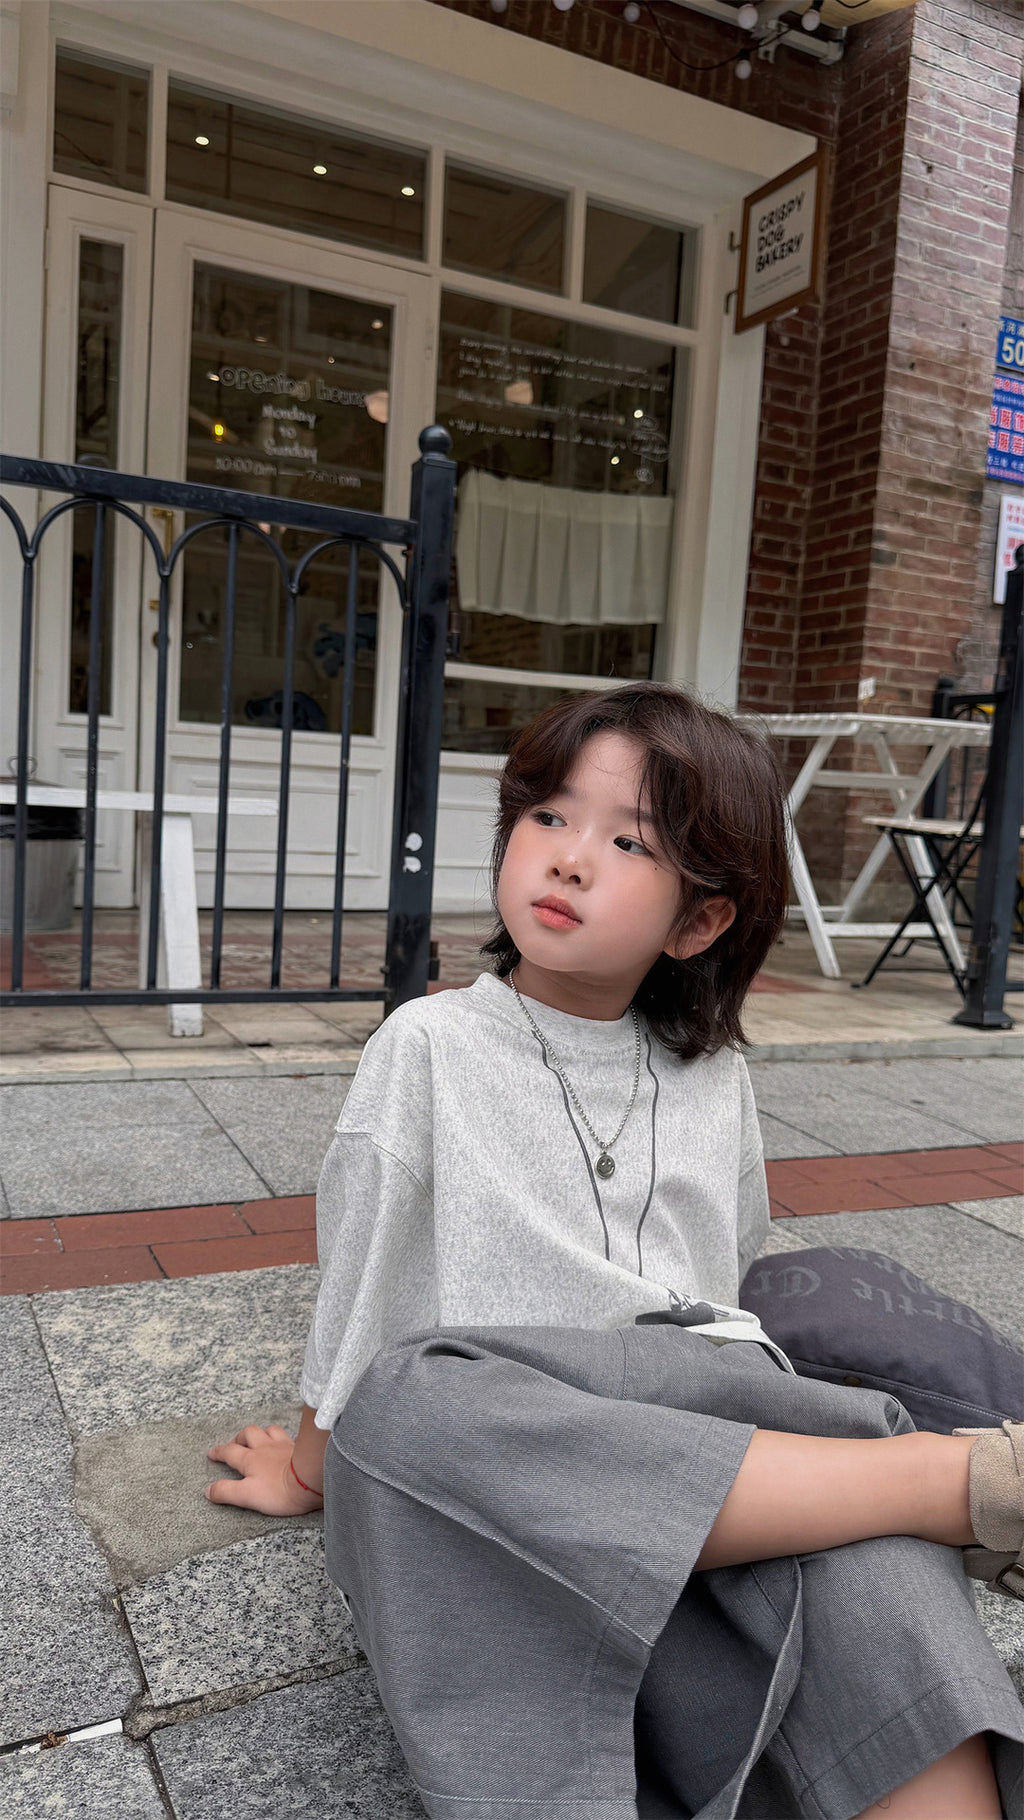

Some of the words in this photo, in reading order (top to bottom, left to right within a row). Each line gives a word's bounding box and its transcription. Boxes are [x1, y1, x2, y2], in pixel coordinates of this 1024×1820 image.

[758, 191, 805, 233] CRISPY
[757, 224, 785, 252] DOG
[755, 232, 804, 273] BAKERY
[262, 403, 317, 430] Monday
[264, 440, 318, 465] Sunday
